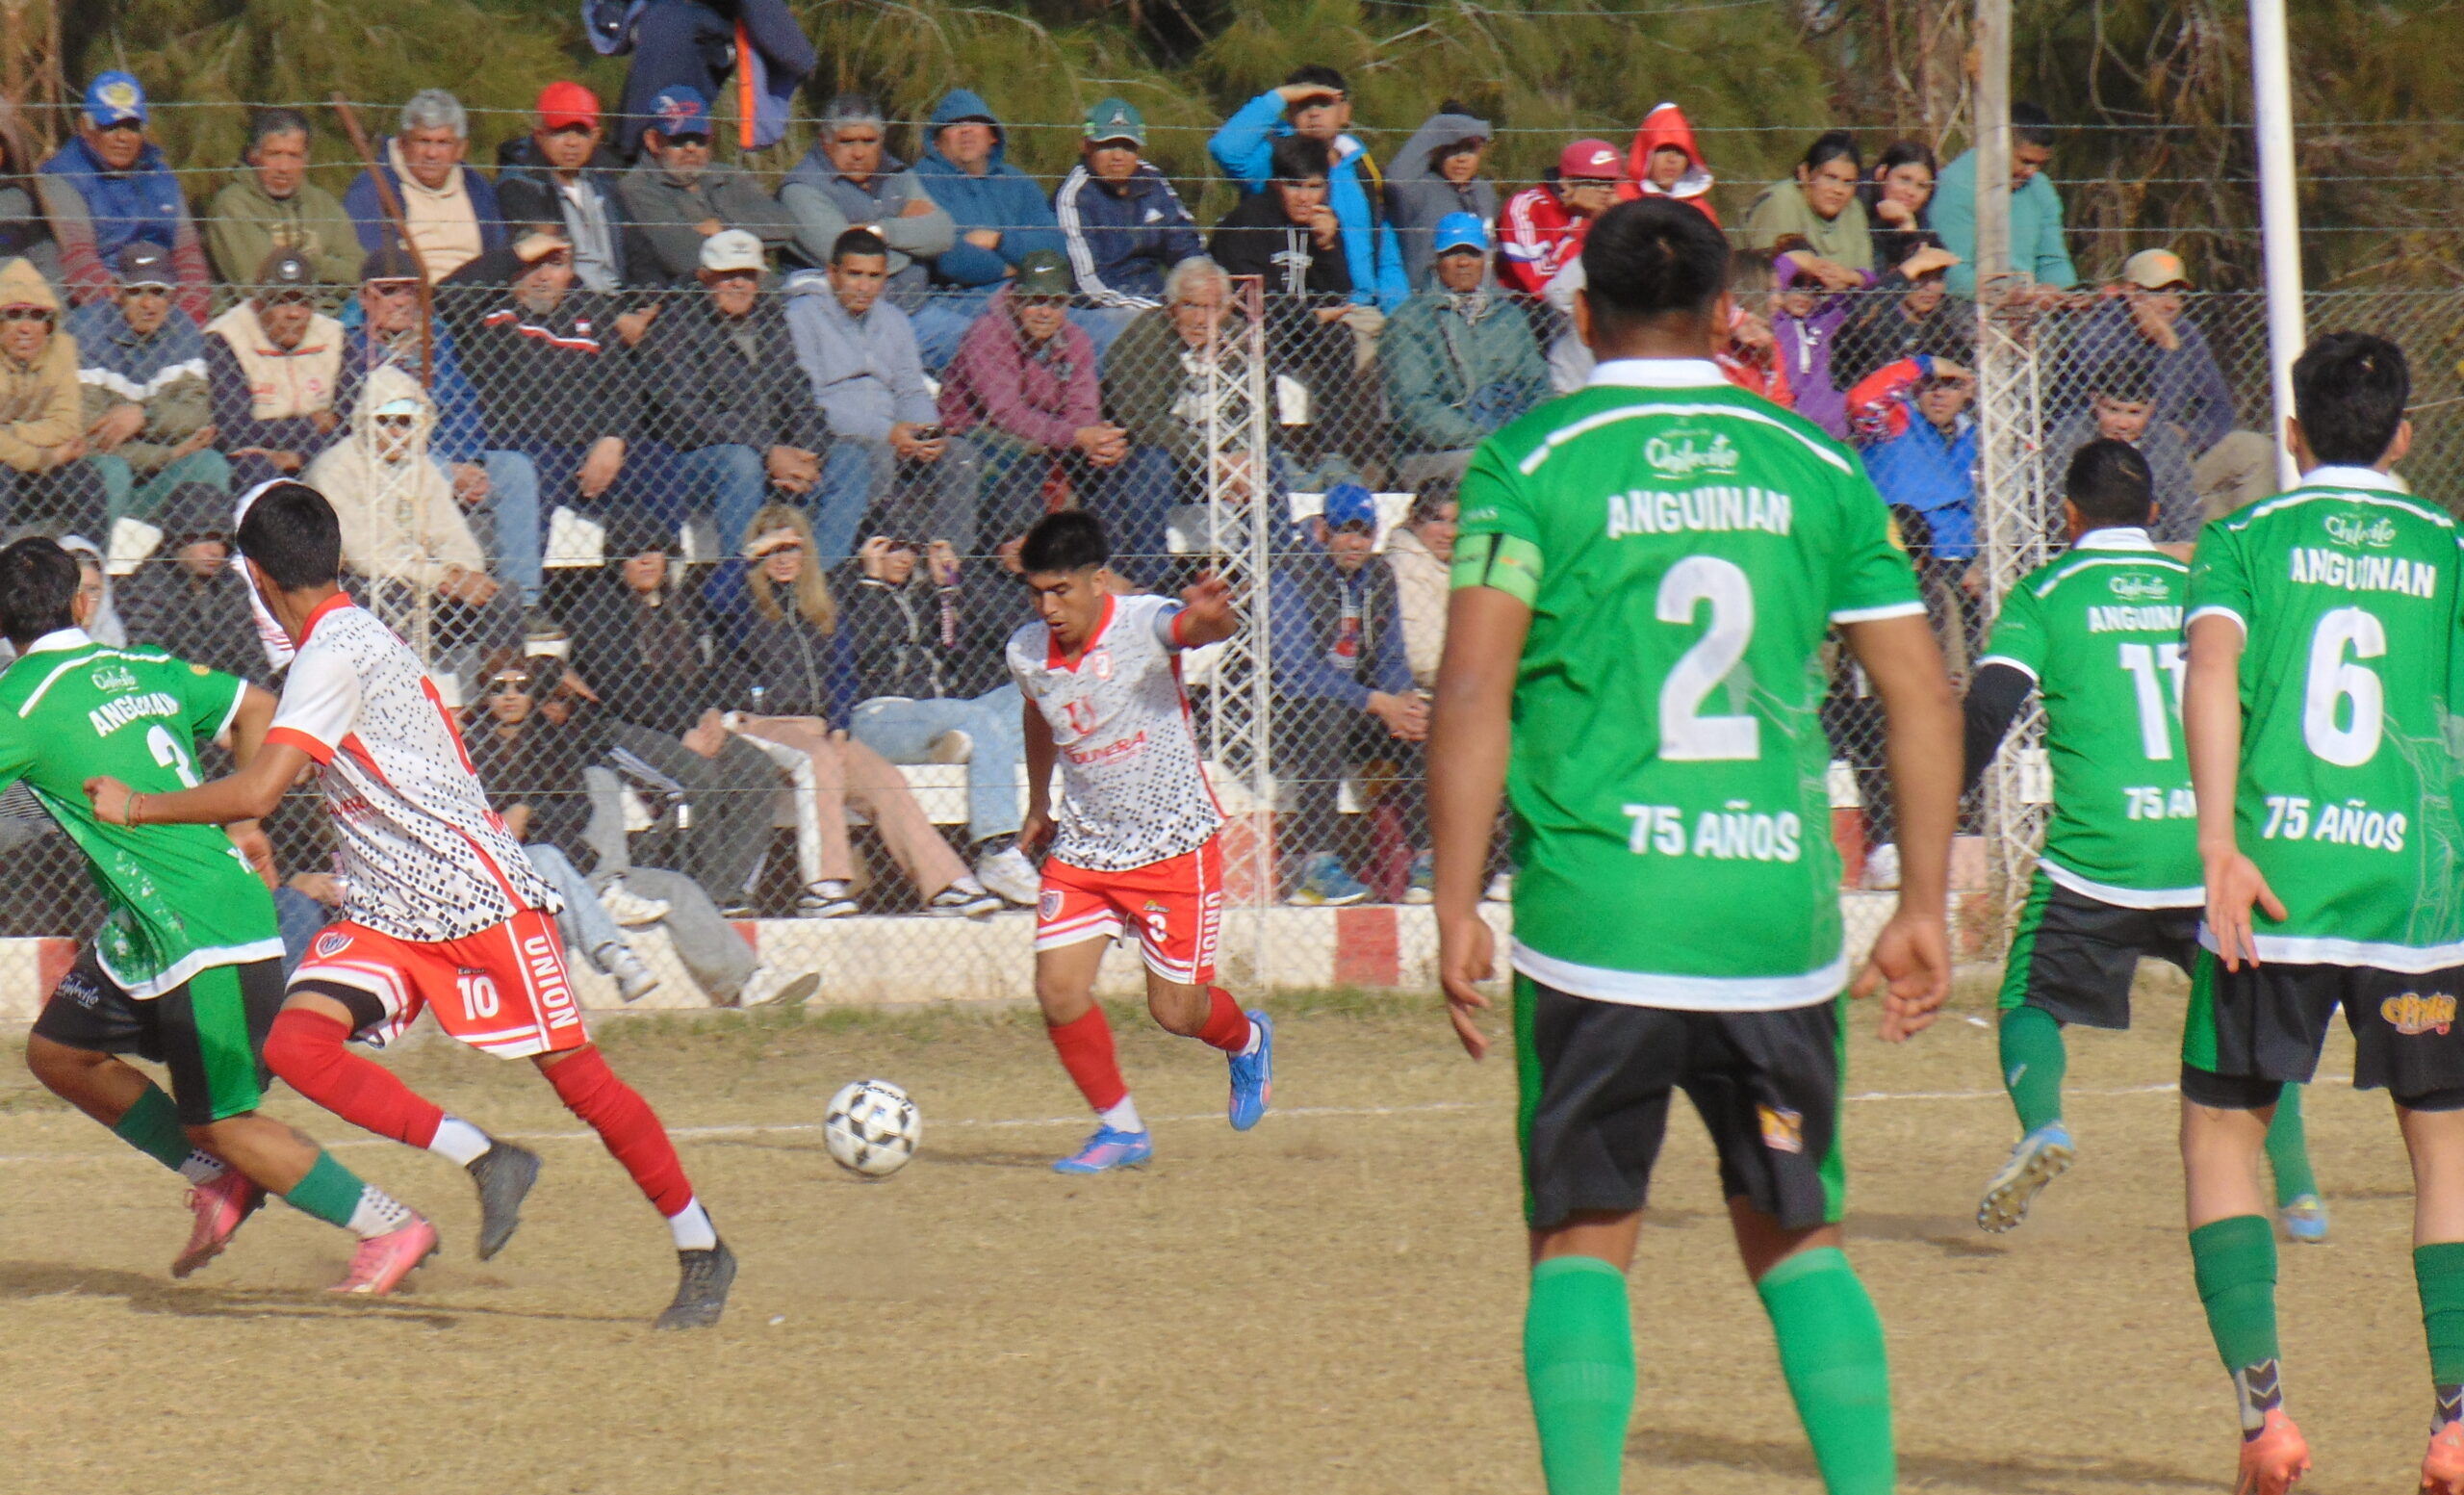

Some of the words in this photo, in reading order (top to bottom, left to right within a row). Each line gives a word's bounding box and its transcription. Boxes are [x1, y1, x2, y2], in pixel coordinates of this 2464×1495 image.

[1606, 485, 1793, 540] ANGUINAN
[2291, 547, 2437, 599] ANGUINAN
[1656, 554, 1761, 760] 2
[2303, 606, 2387, 767] 6
[1622, 803, 1686, 856] 75
[1692, 799, 1802, 863] AÑOS
[2123, 786, 2165, 820] 75
[2263, 795, 2310, 840] 75
[2313, 799, 2407, 853] AÑOS
[1199, 891, 1221, 967] UNION
[456, 975, 500, 1021] 10
[524, 935, 579, 1031] UNION
